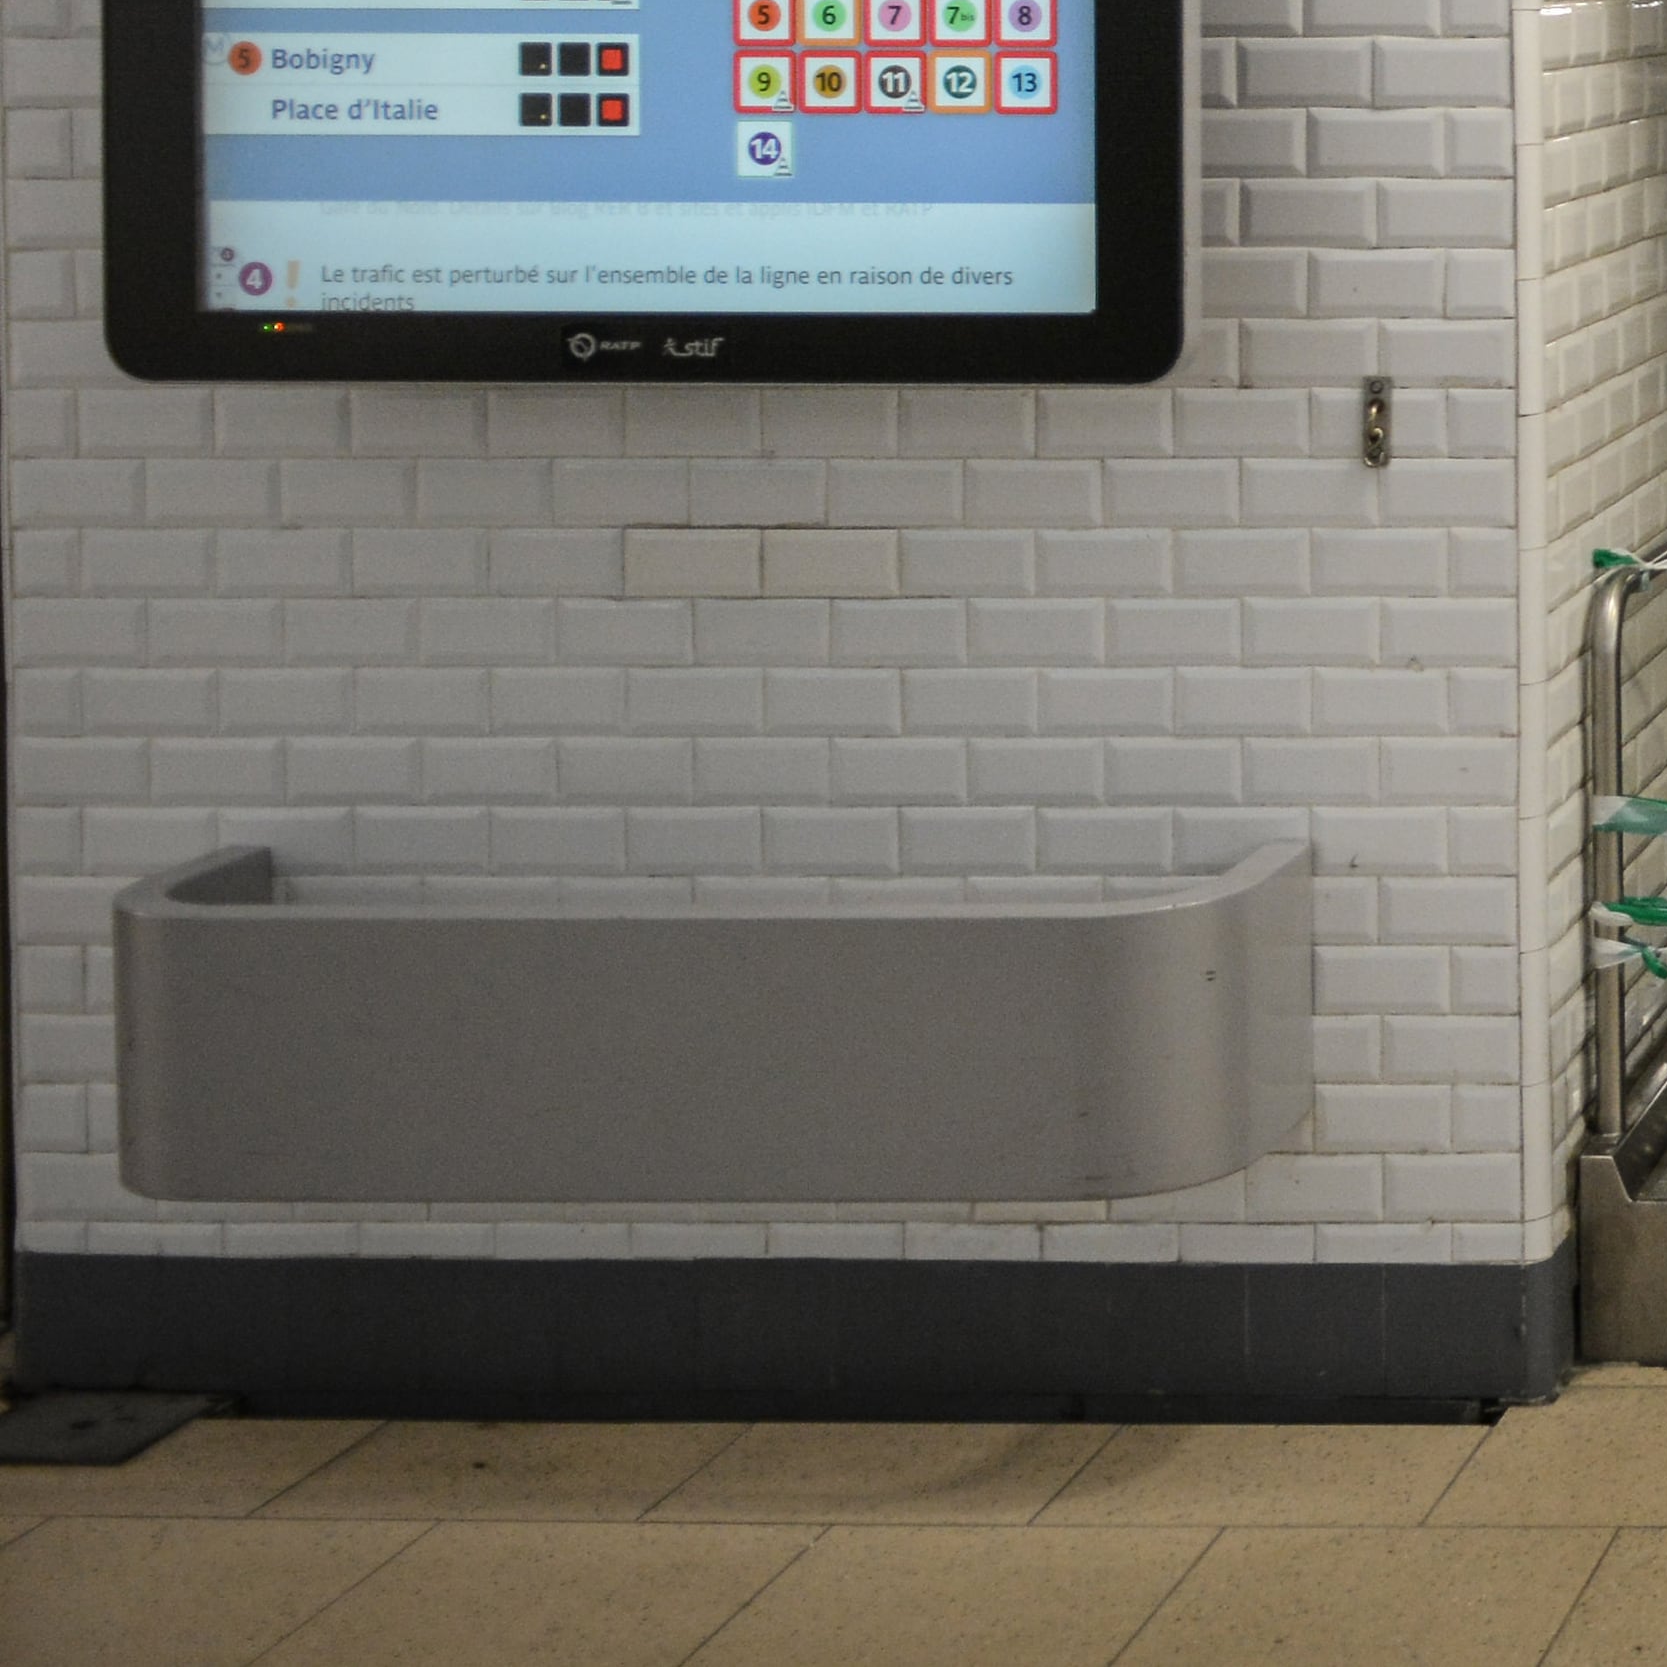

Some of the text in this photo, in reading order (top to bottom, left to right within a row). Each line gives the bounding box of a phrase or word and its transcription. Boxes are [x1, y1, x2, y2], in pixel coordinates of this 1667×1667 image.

[757, 4, 770, 26] 5
[822, 4, 837, 26] 6
[888, 4, 902, 26] 7
[1017, 4, 1032, 26] 8
[237, 47, 375, 75] 5 Bobigny
[756, 71, 1037, 93] 9 10 11 12 13
[271, 98, 438, 121] Place d’Italie
[750, 139, 778, 160] 14
[245, 264, 1014, 290] 4 Le trafic est perturbé sur l'ensemble de la ligne en raison de divers
[320, 292, 415, 311] incidents
